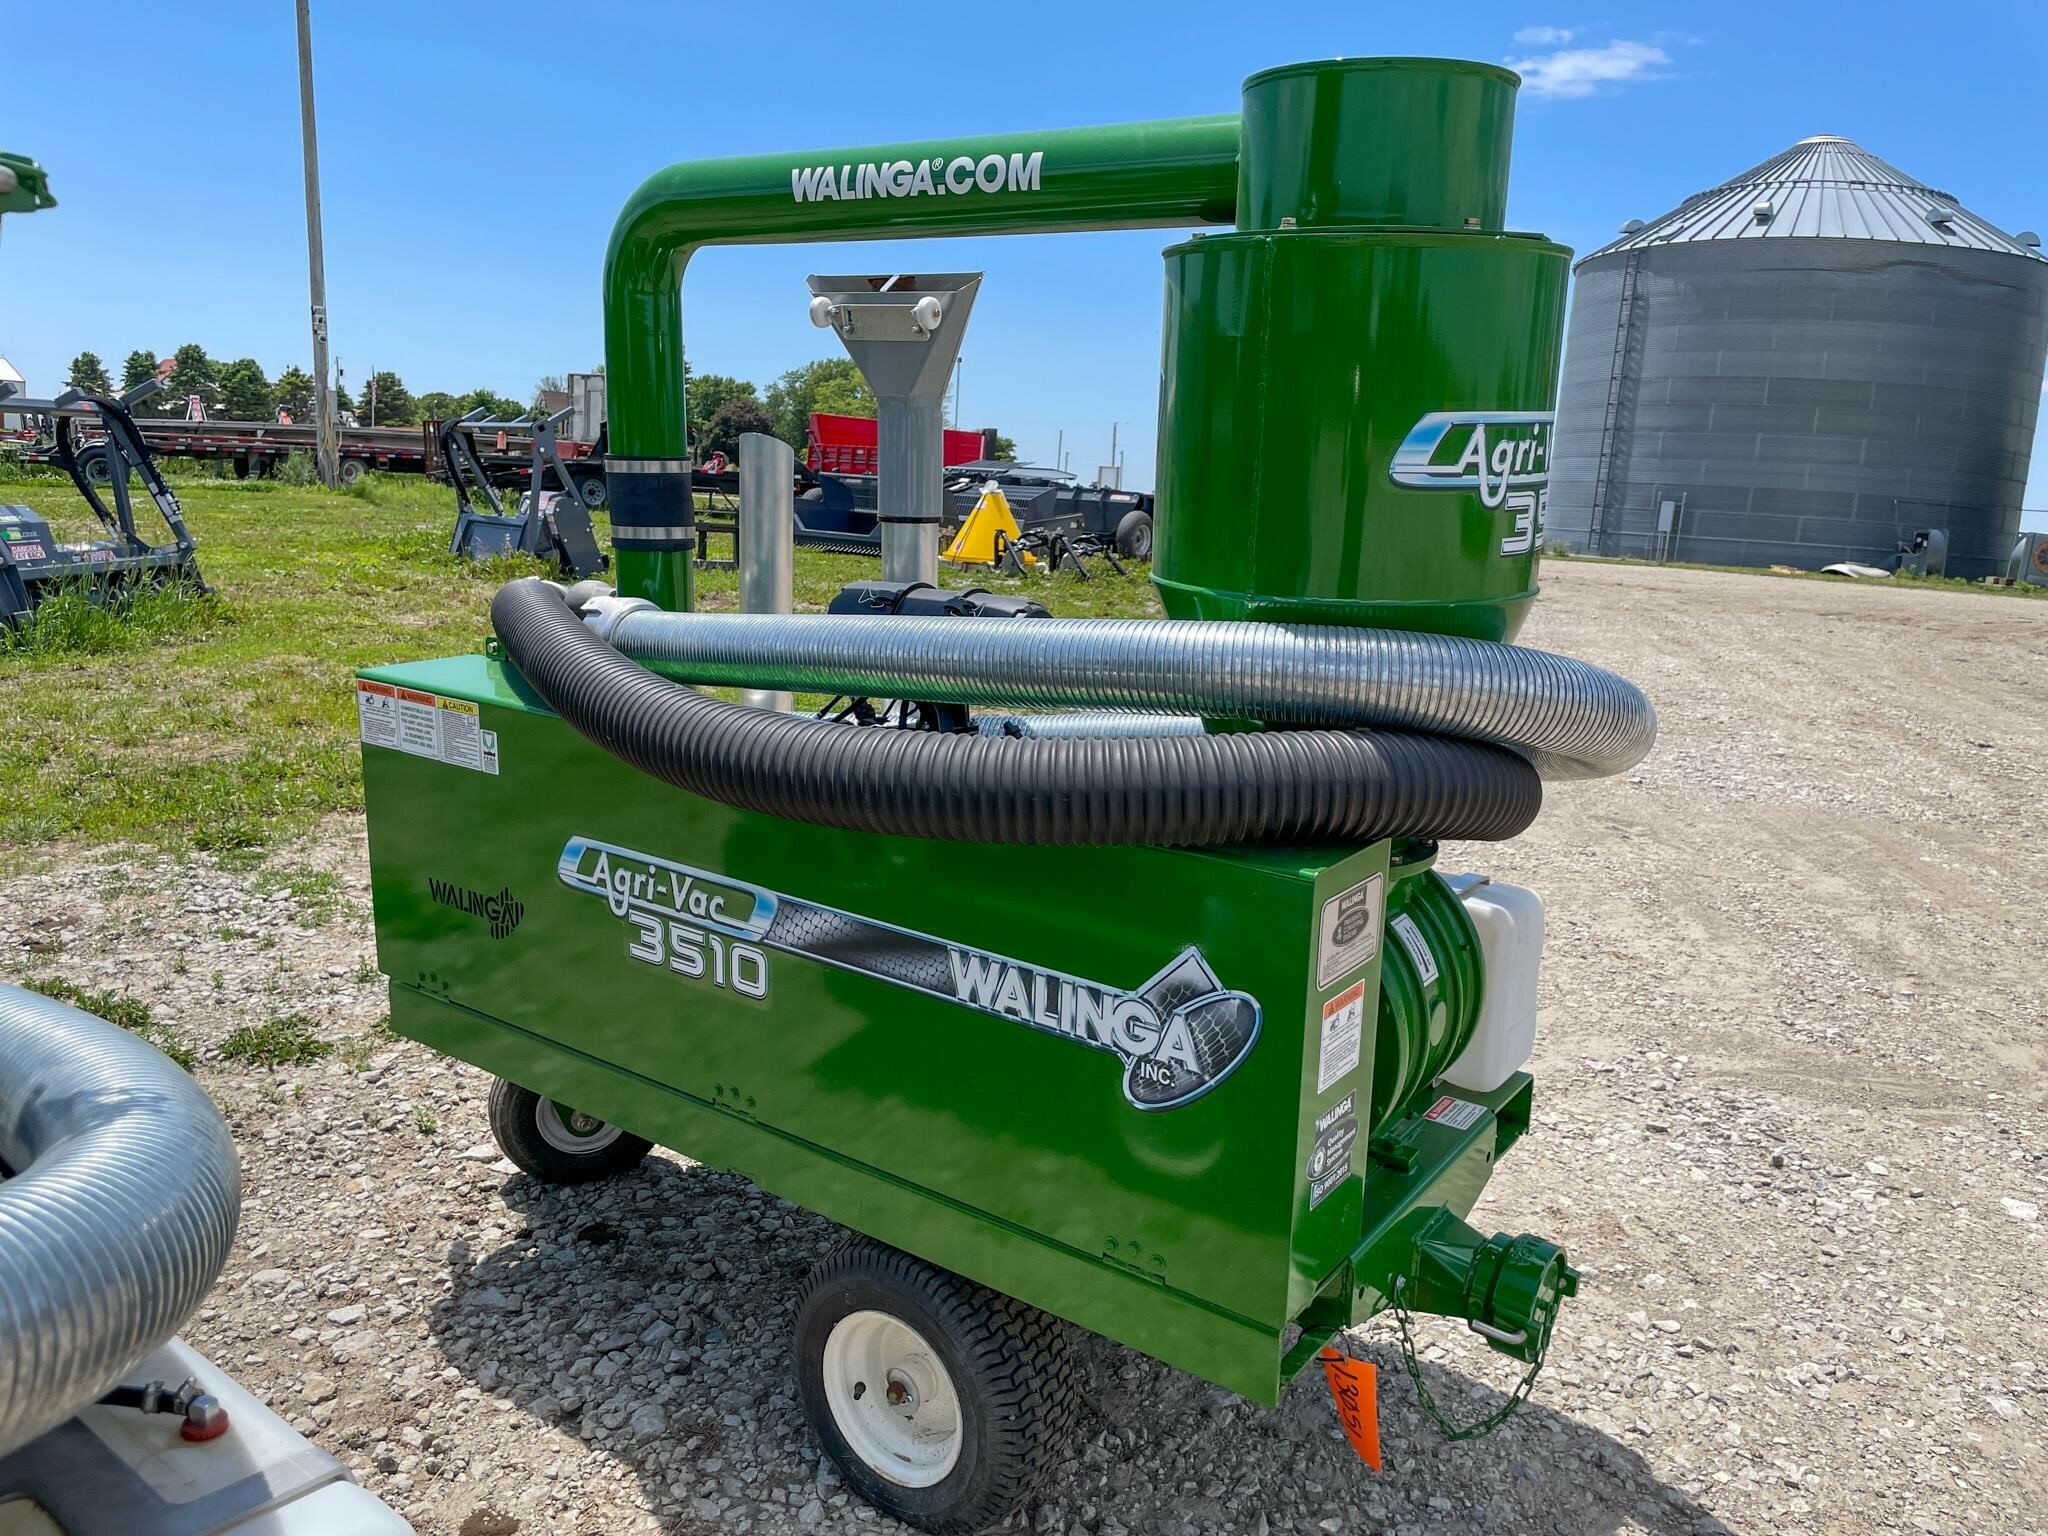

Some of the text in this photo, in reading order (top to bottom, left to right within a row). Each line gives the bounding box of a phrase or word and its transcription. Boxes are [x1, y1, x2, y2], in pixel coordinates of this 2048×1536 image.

[448, 702, 474, 714] CAUTION
[592, 850, 725, 917] Agri-Vac
[428, 877, 524, 940] WALINGA
[1341, 890, 1364, 911] WALINGA
[628, 910, 768, 1000] 3510
[950, 946, 1200, 1074] WALINGA
[1140, 1062, 1176, 1087] INC.
[1319, 1095, 1352, 1132] WALINGA
[1326, 1127, 1357, 1158] Management
[1327, 1128, 1345, 1147] Quality
[1326, 1147, 1343, 1167] System
[1313, 1179, 1324, 1199] ISO
